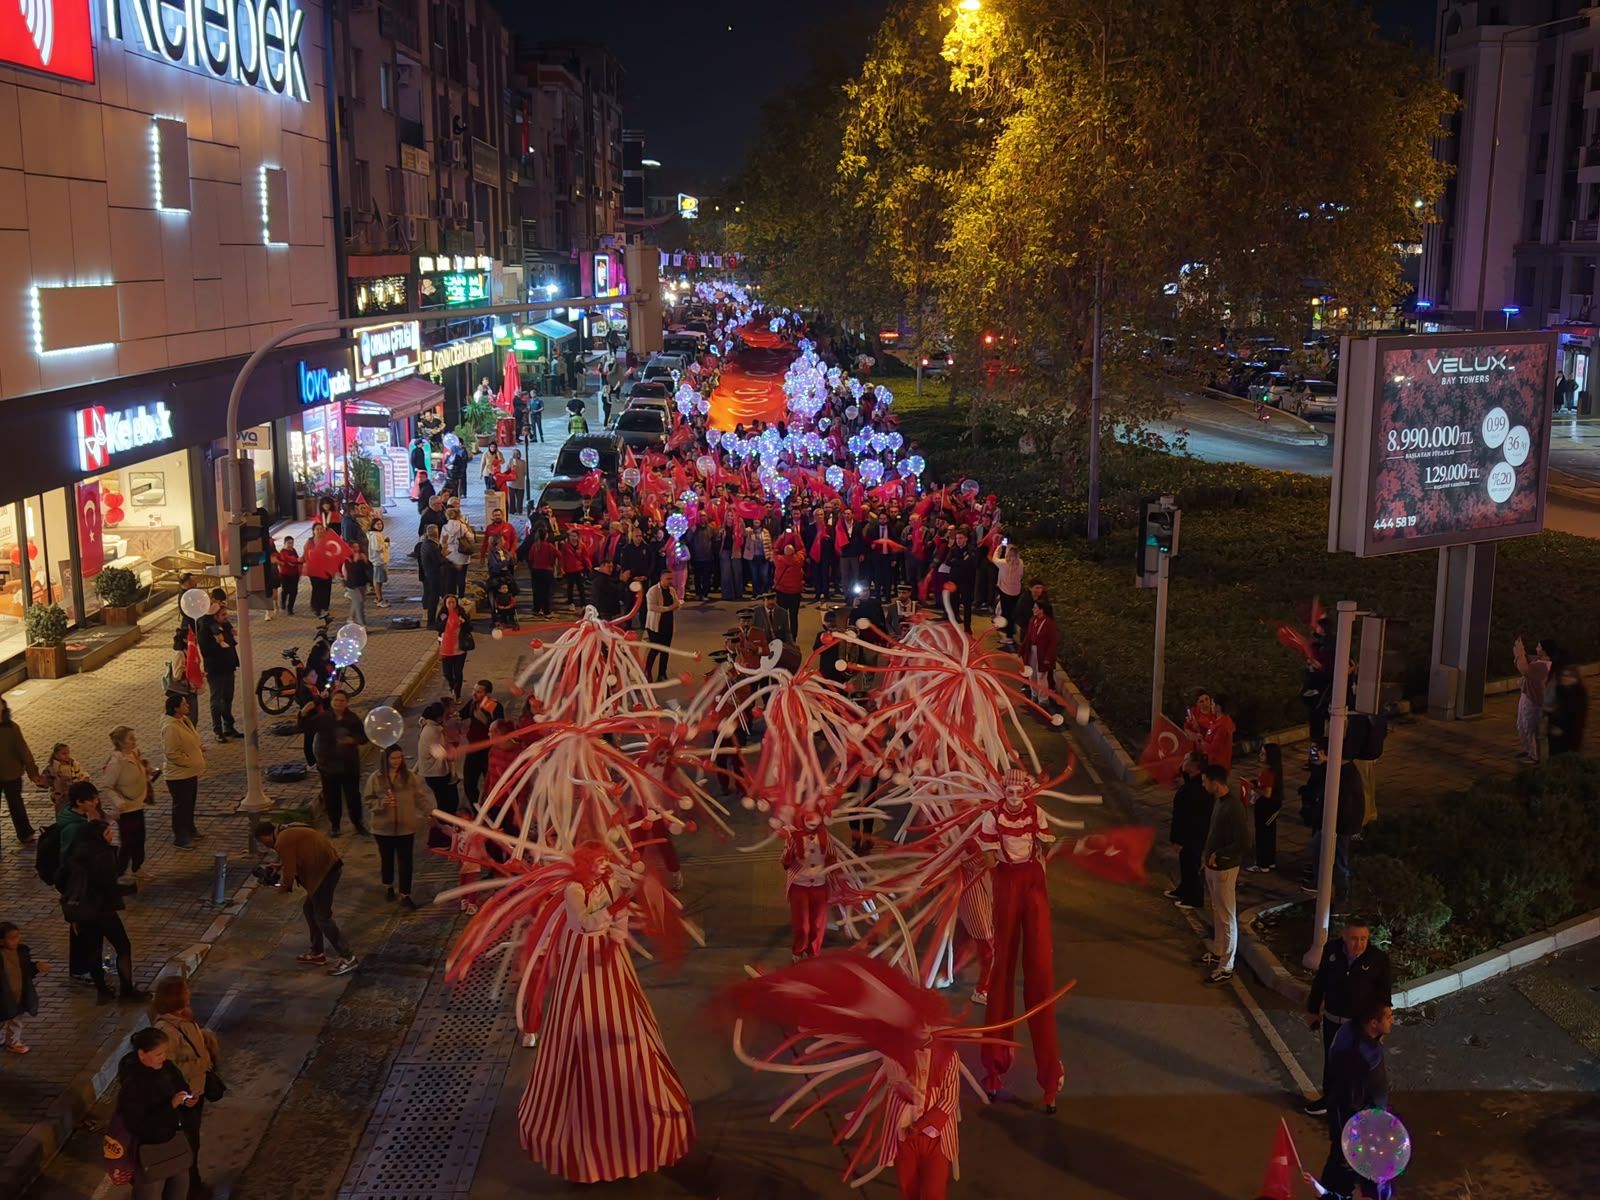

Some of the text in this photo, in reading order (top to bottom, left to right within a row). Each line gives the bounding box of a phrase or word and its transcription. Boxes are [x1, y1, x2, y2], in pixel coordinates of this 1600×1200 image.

[1427, 355, 1506, 375] VELUX
[1441, 374, 1490, 386] BAY TOWERS
[1373, 515, 1417, 530] 444 5819
